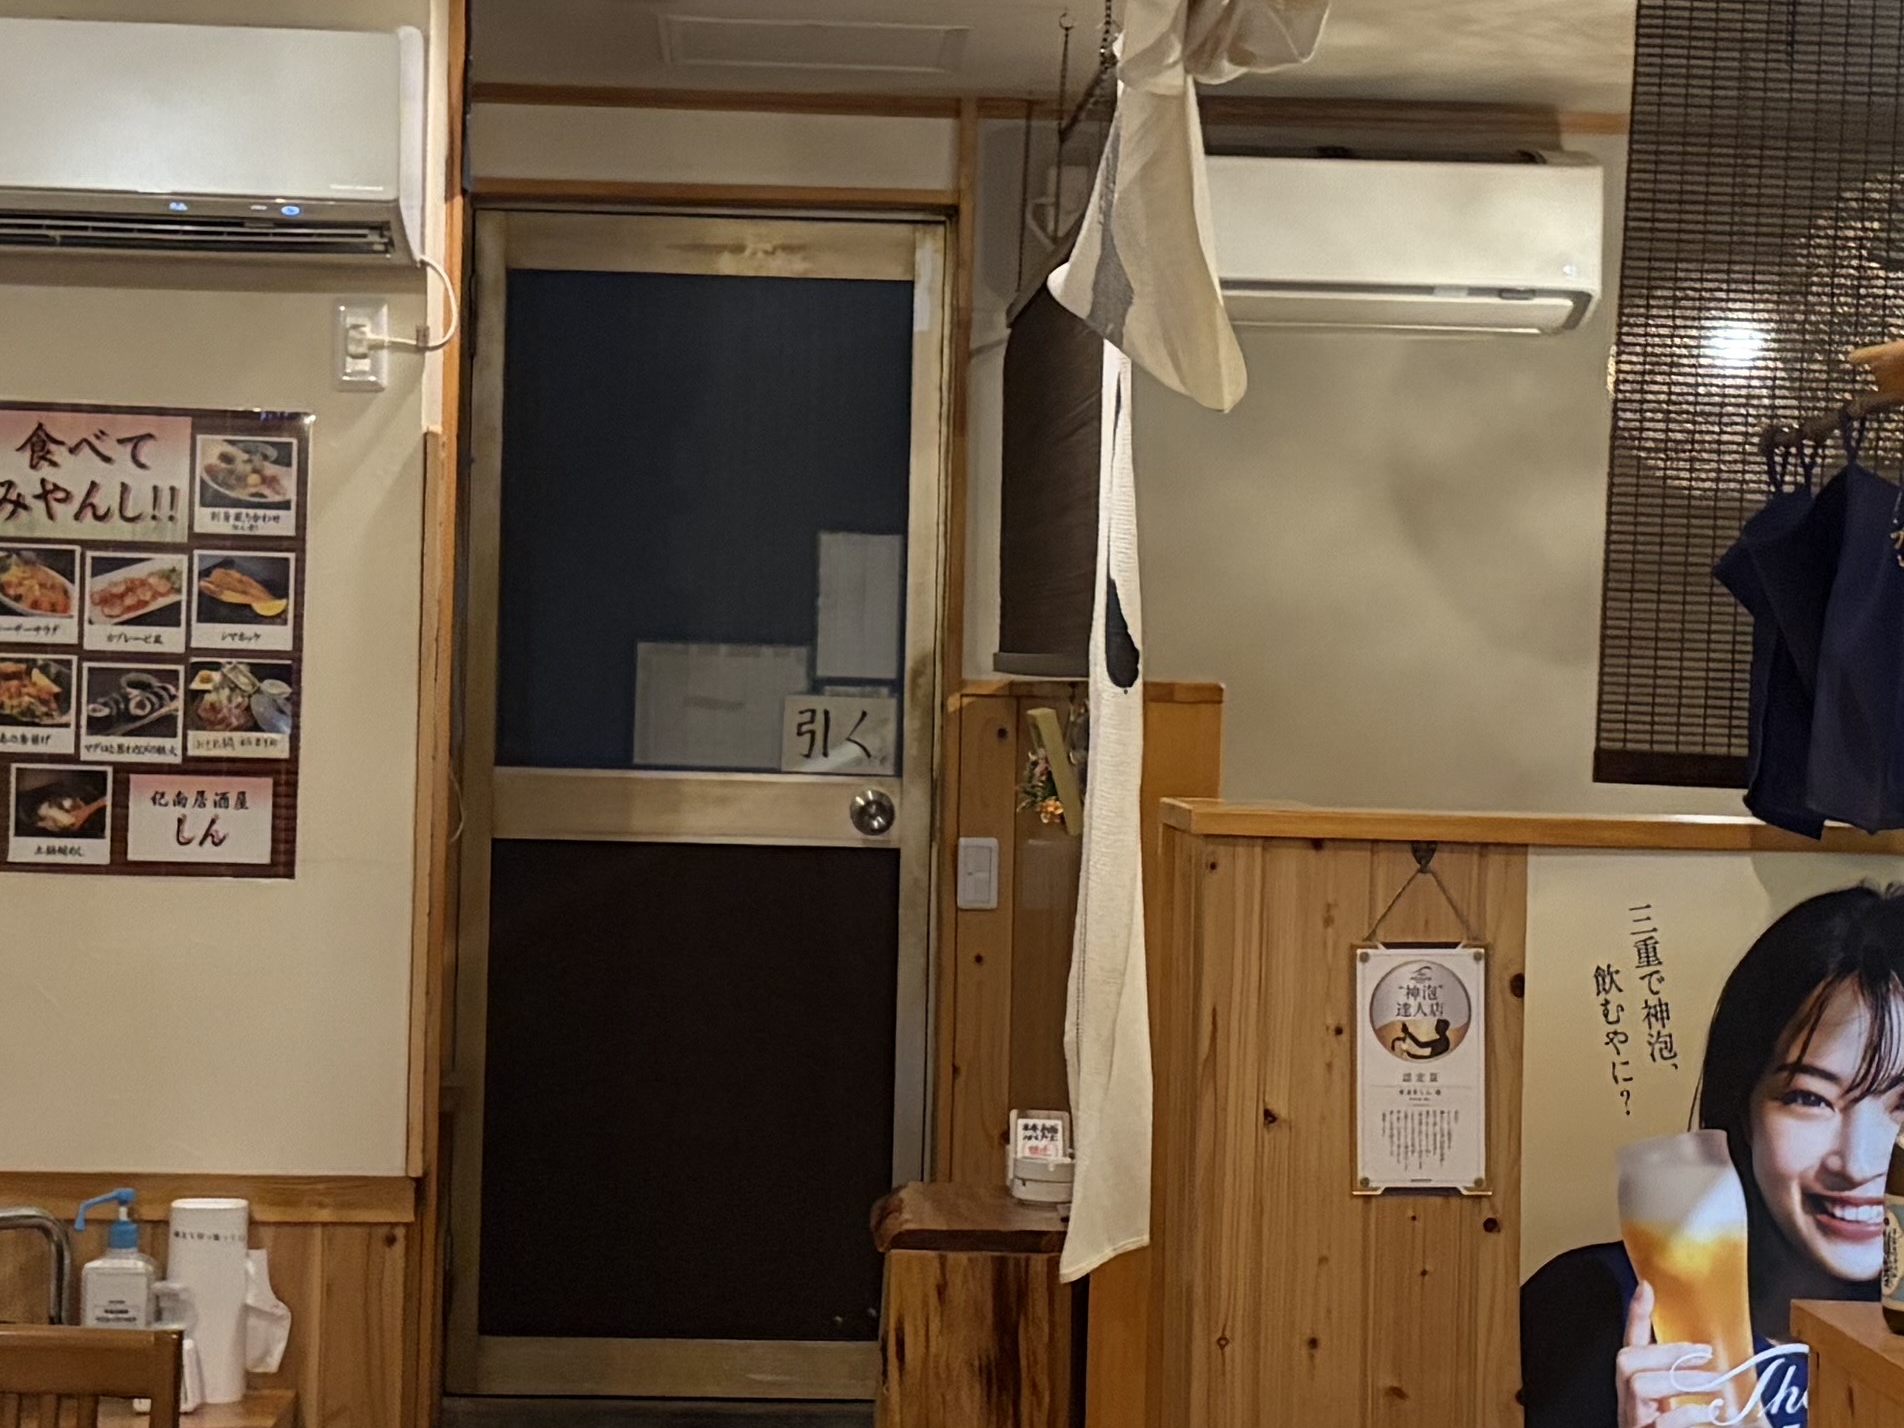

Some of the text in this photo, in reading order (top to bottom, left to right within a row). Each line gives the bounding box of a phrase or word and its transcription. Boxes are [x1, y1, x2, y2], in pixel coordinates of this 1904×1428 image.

[15, 421, 159, 471] 食べて
[796, 708, 872, 758] 引く
[176, 813, 229, 847] しん
[1396, 1002, 1444, 1018] 達人店
[1629, 904, 1679, 1070] 三重で神泡、
[1670, 1343, 1810, 1426] Th
